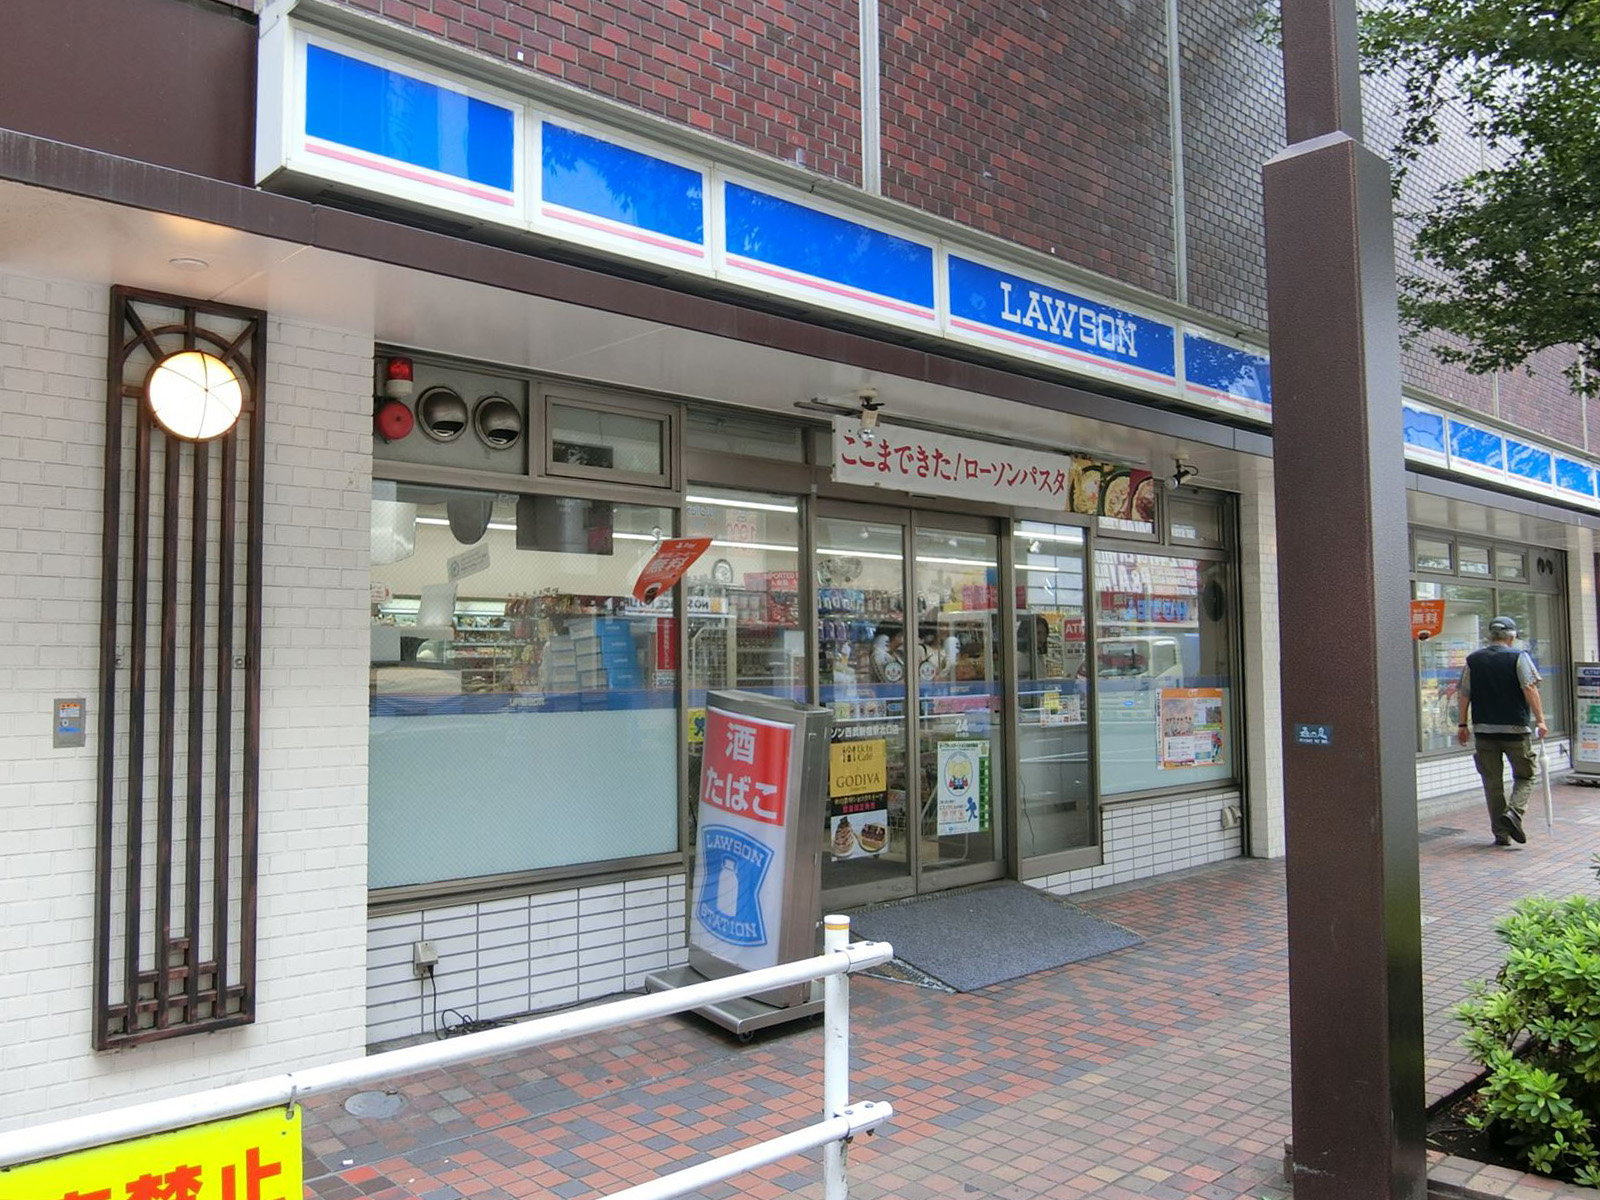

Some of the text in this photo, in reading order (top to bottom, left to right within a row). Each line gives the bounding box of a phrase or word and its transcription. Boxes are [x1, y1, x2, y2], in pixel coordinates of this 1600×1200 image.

[1000, 281, 1138, 357] LAWSON
[725, 722, 757, 765] 酒
[955, 719, 969, 732] 24
[705, 766, 777, 819] たばこ
[836, 772, 880, 788] GODIVA
[706, 834, 764, 867] LAWSON
[702, 902, 758, 938] STATION
